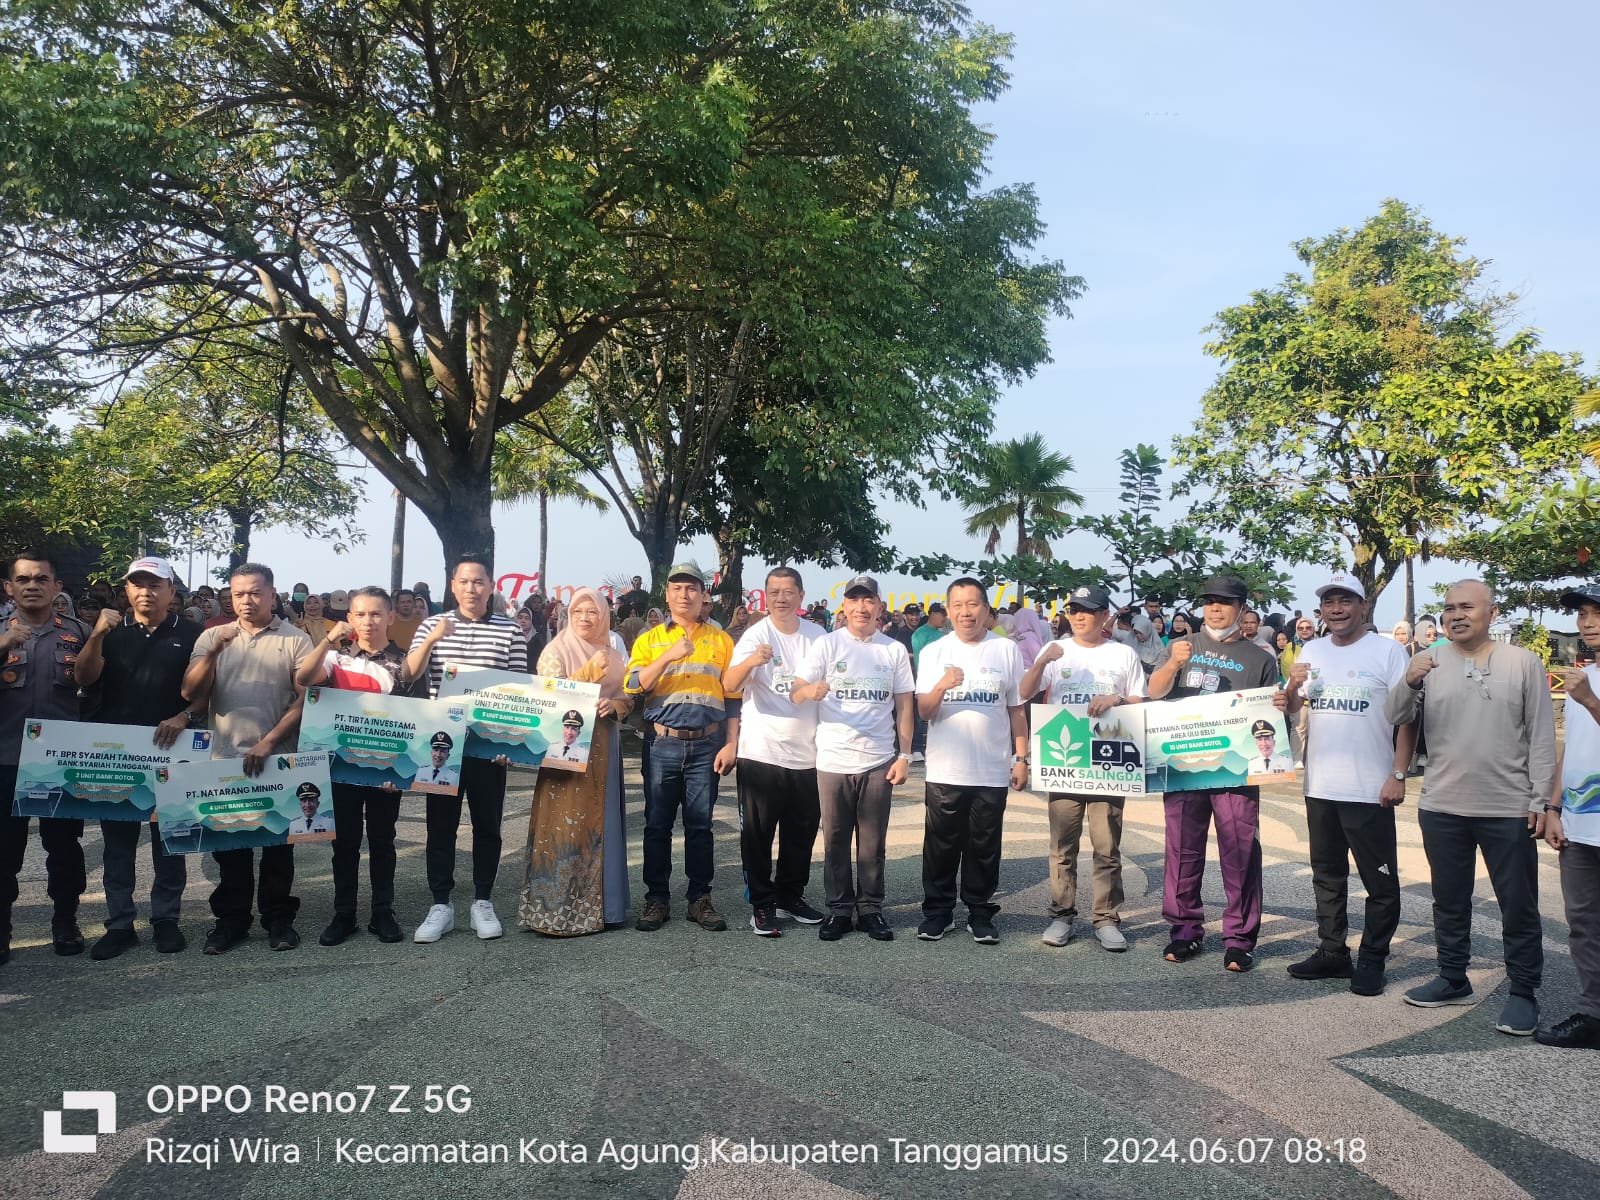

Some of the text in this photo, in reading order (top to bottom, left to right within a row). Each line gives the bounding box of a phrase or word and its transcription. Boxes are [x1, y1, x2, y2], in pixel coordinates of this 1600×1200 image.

[1190, 654, 1244, 672] Manado
[557, 680, 576, 690] PLN
[490, 692, 530, 704] INDONESIA
[531, 698, 558, 708] POWER
[836, 690, 890, 702] CLEANUP
[942, 690, 1000, 704] CLEANUP
[474, 700, 491, 708] UNIT
[511, 704, 525, 712] ULU
[526, 706, 543, 715] BELU
[1310, 699, 1370, 712] CLEANUP
[334, 714, 416, 730] PT. TIRTA INVESTAMA
[1181, 720, 1222, 730] GEOTHERMAL
[1223, 716, 1248, 726] ENERGY
[334, 724, 414, 740] PABRIK TANGGAMUS
[1170, 732, 1187, 740] AREA
[46, 750, 171, 764] PT. BPR SYARIAH TANGGAMUS
[79, 761, 110, 769] SYARIAH
[1040, 768, 1143, 782] BANK SALINGDA
[186, 784, 284, 800] PT. NATARANG MINING
[1041, 778, 1142, 793] TANGGAMUS
